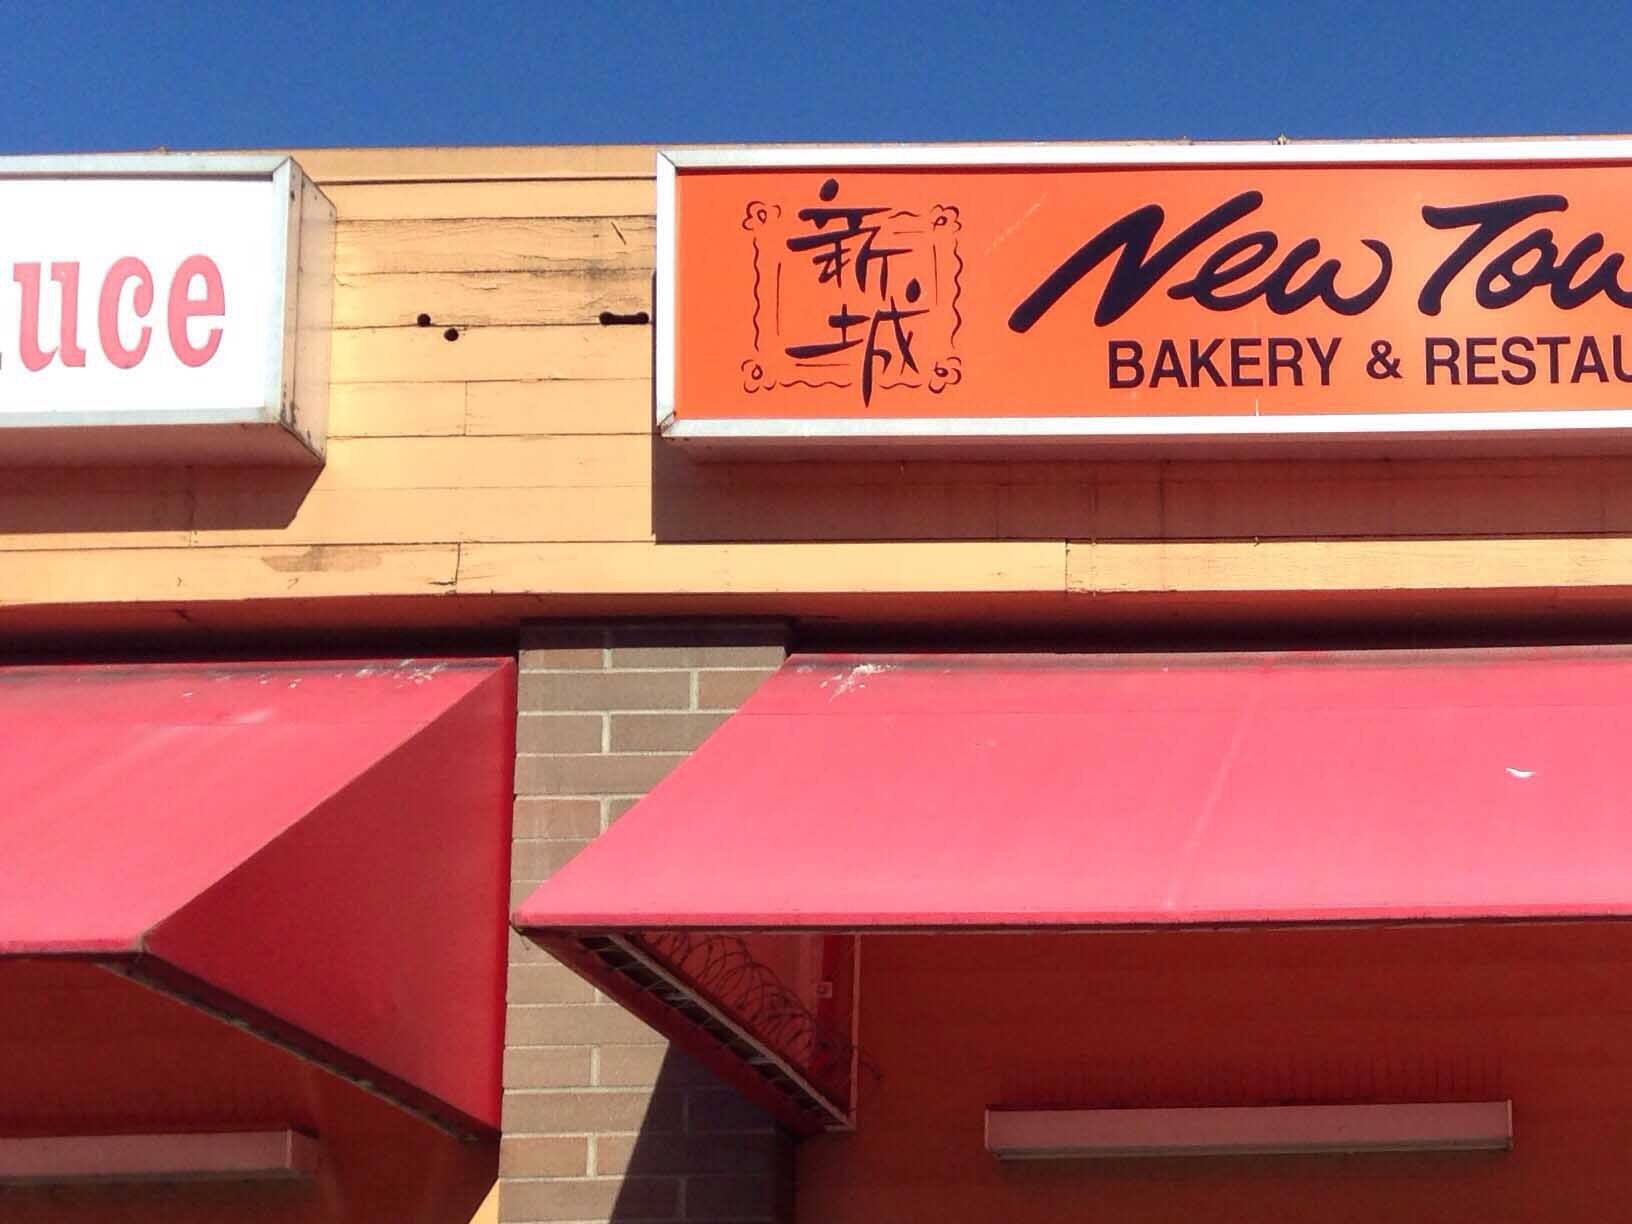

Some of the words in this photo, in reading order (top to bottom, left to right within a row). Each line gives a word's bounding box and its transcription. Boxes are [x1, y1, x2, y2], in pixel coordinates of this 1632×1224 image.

[0, 253, 226, 373] uce
[1007, 190, 1393, 334] New
[1108, 337, 1342, 389] BAKERY
[1366, 339, 1402, 380] &
